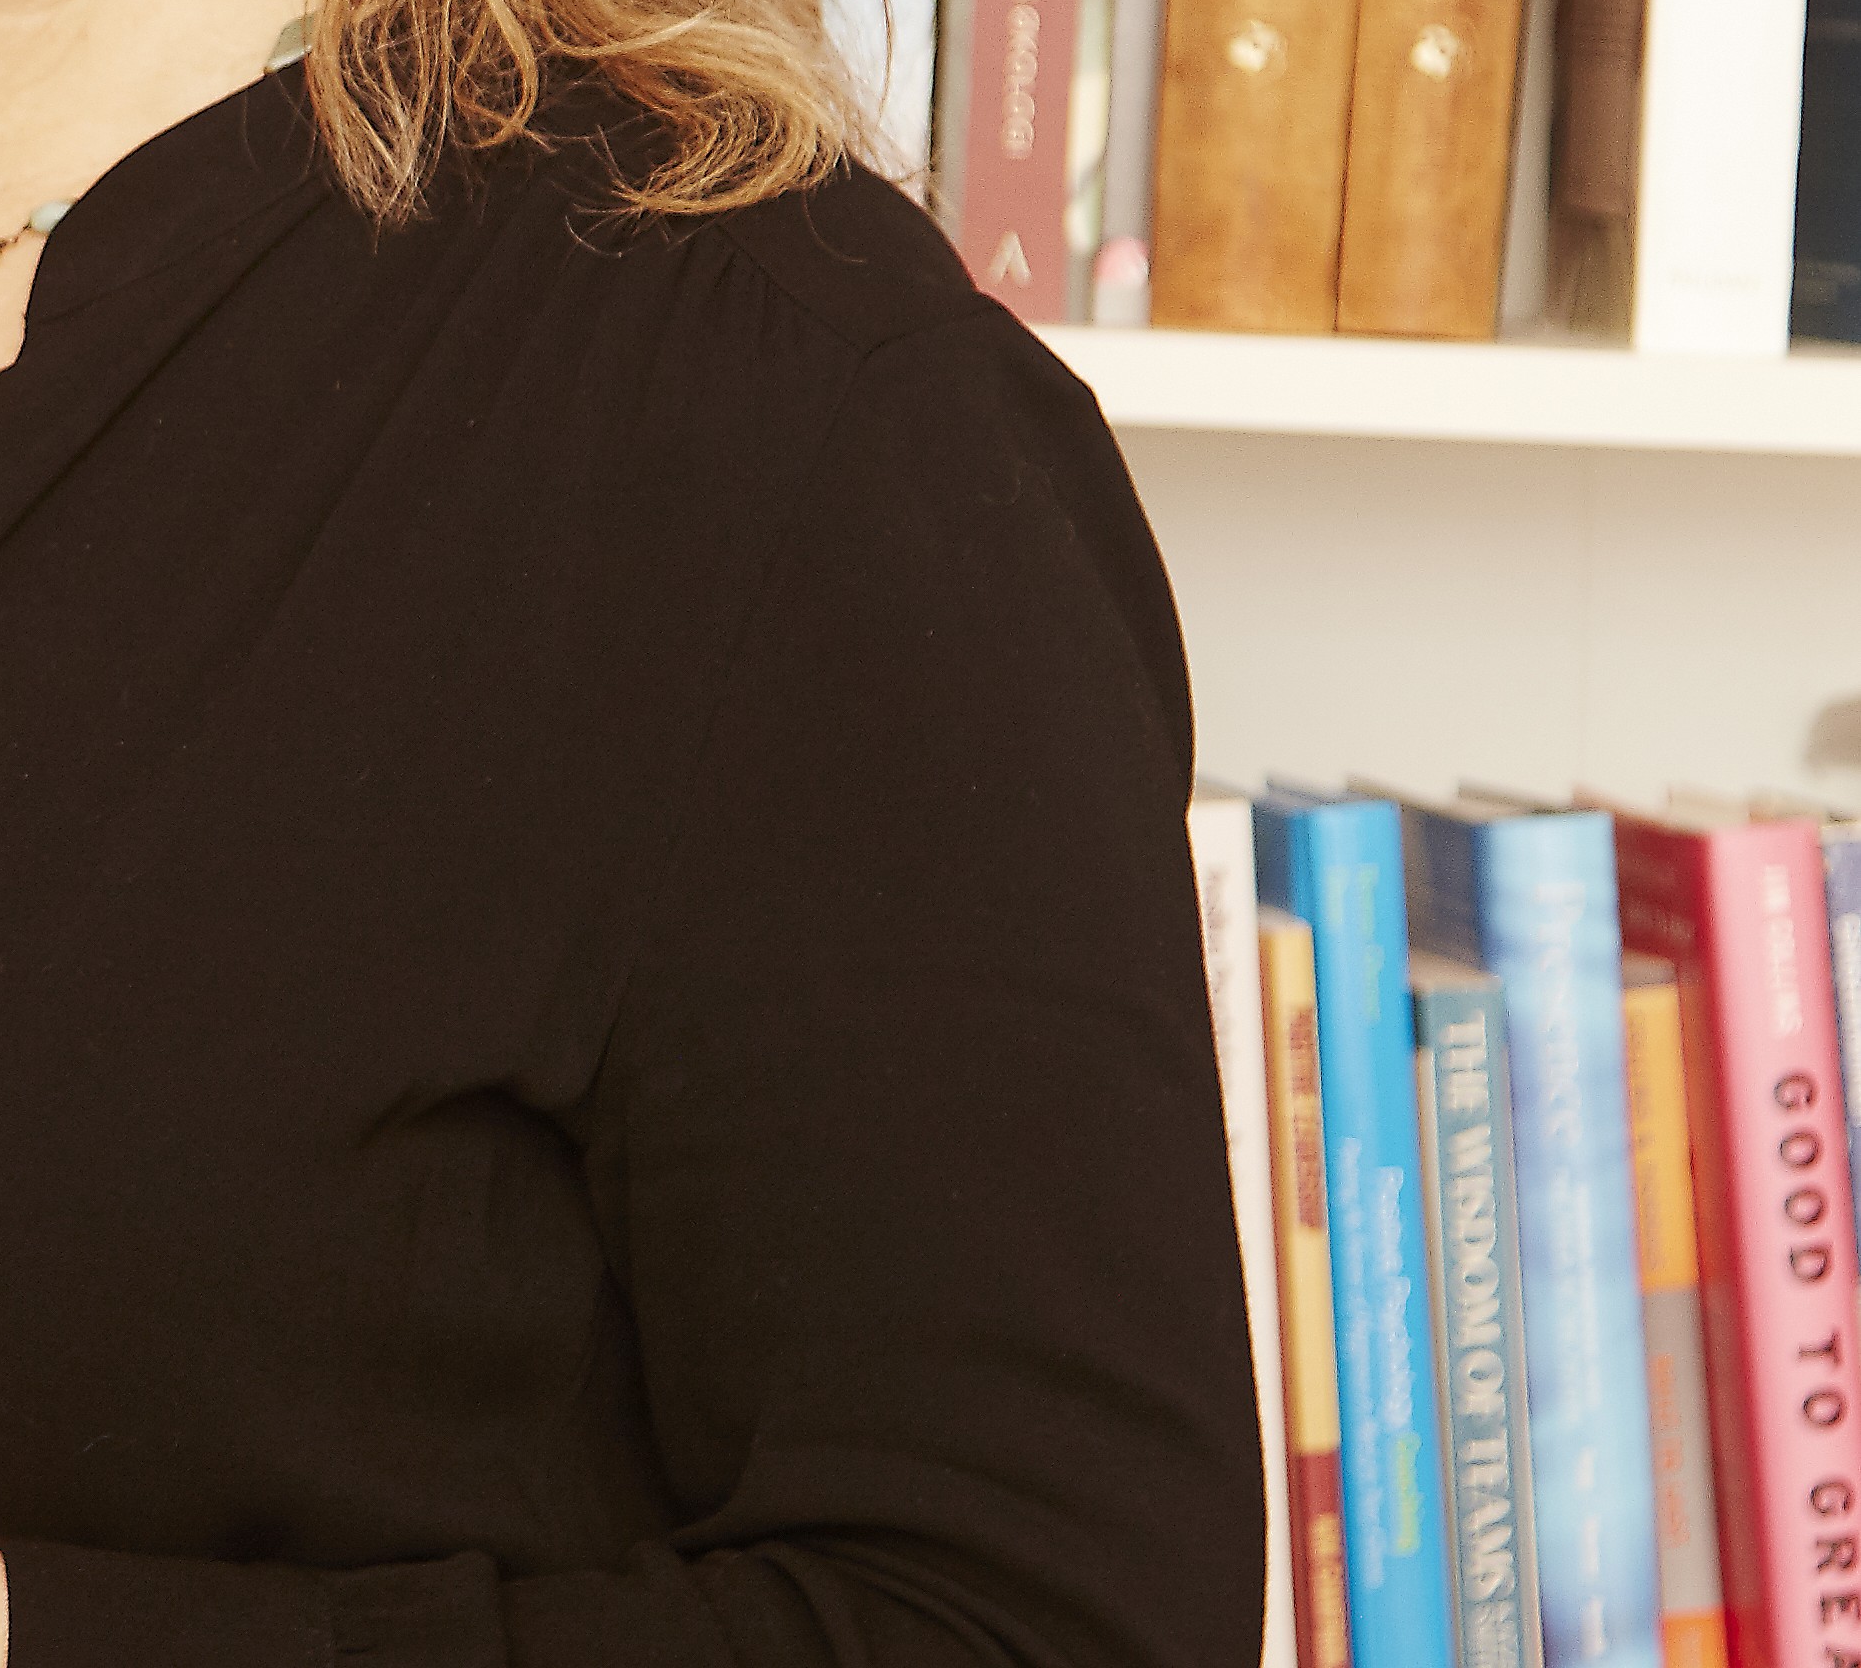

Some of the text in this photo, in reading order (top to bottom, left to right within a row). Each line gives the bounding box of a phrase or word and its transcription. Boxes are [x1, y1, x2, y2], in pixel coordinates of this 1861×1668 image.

[999, 4, 1042, 158] ØKOLOGI
[1772, 1071, 1837, 1285] GOOD
[1438, 1008, 1519, 1602] THE WISDOM OF TEAMS
[1794, 1330, 1849, 1429] TO
